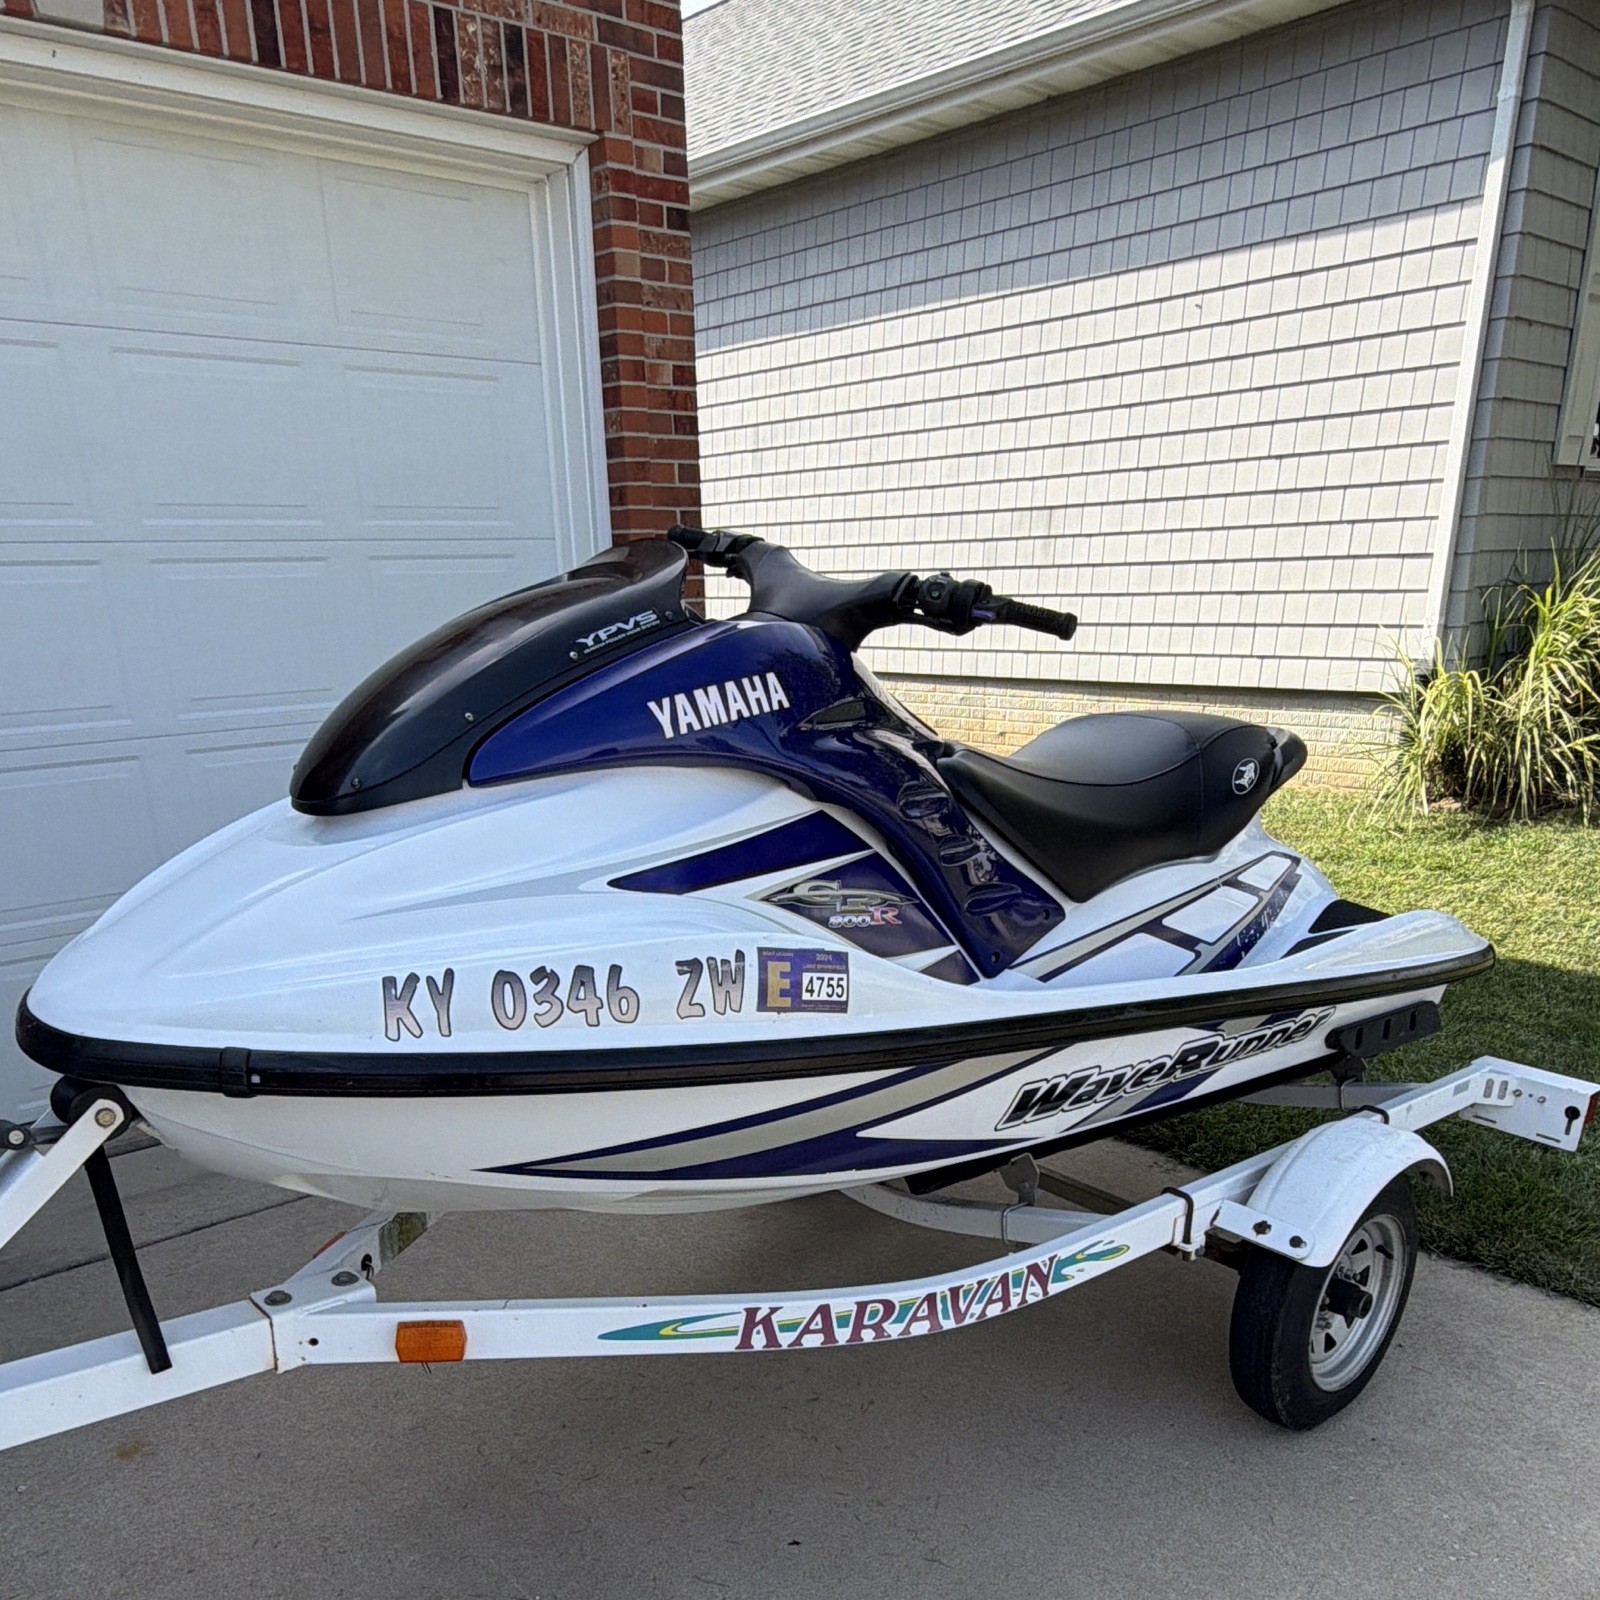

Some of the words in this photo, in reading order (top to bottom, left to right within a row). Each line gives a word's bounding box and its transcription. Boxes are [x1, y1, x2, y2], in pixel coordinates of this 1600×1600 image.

[575, 610, 659, 648] YPVS
[647, 671, 790, 739] YAMAHA
[766, 961, 792, 1007] E
[816, 953, 833, 962] 2024
[382, 967, 455, 1042] KY
[491, 964, 640, 1030] 0346
[675, 949, 746, 1020] ZW
[805, 976, 845, 998] 4755
[995, 1005, 1337, 1132] WaveRunner
[734, 1254, 1059, 1351] KARAVAN
